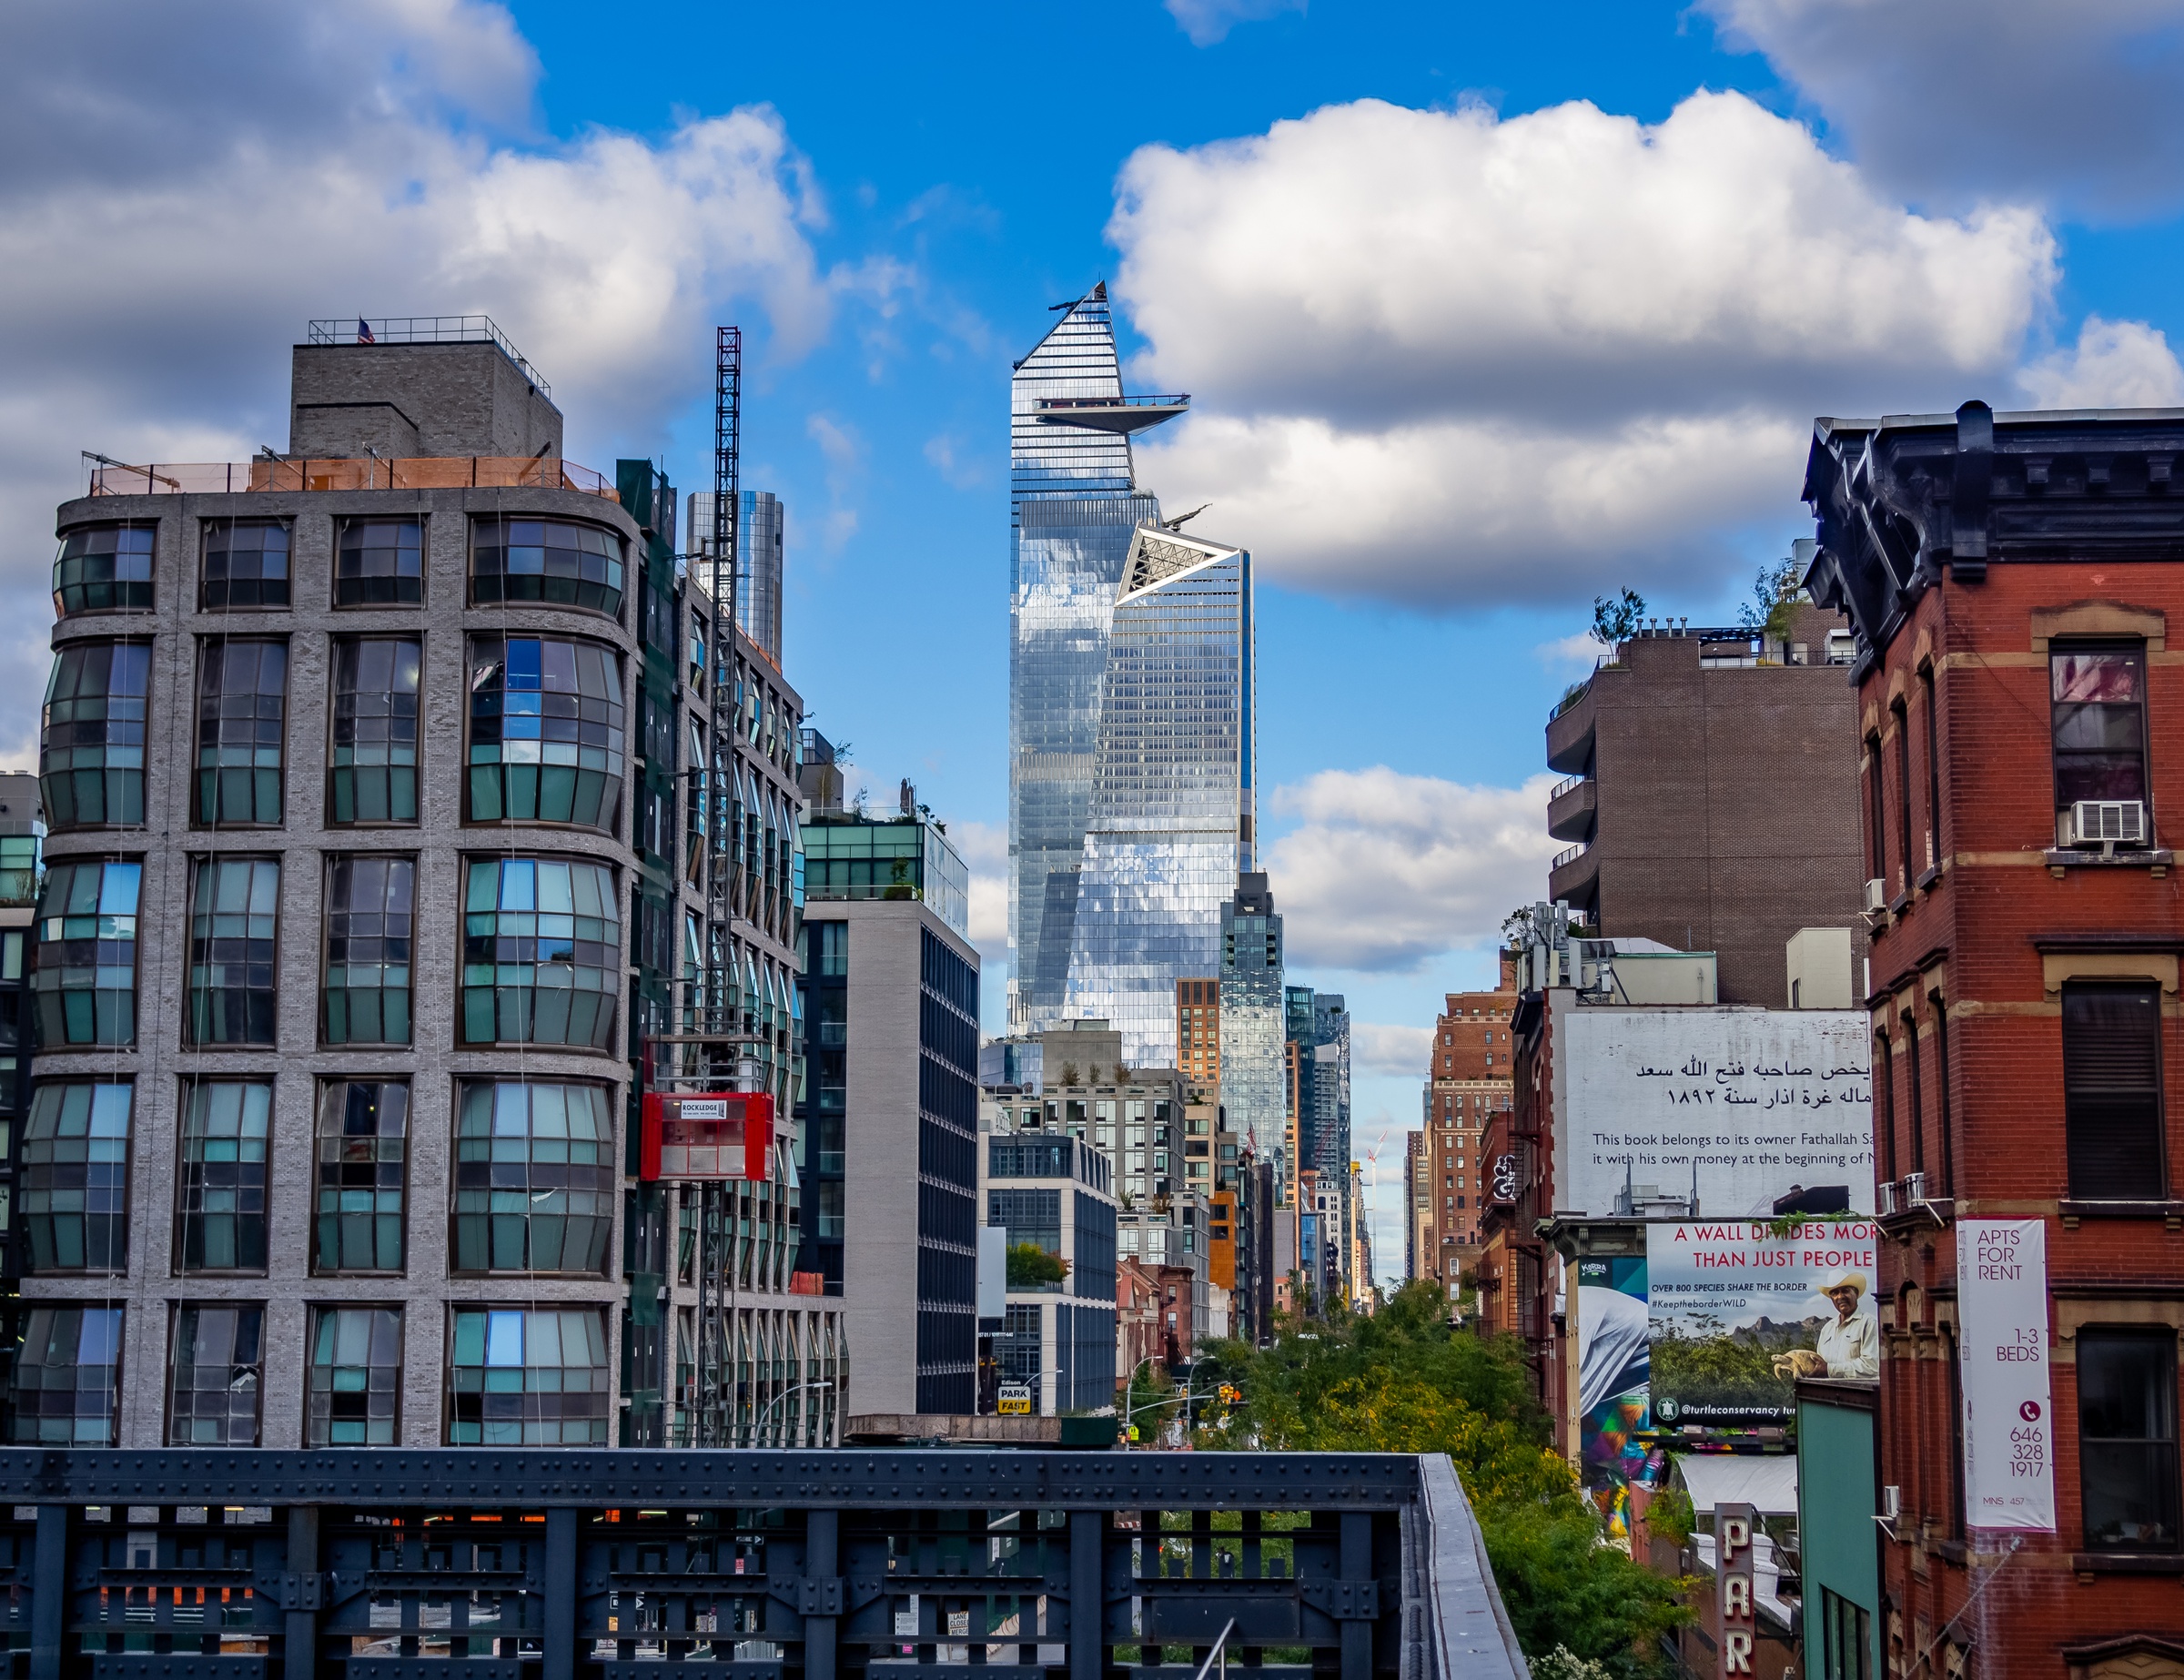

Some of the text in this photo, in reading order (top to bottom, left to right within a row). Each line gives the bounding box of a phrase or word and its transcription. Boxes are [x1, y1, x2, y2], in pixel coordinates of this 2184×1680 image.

[1636, 1066, 1673, 1077] سعد
[1681, 1054, 1706, 1076] الله
[1715, 1060, 1744, 1084] فتح
[1753, 1060, 1812, 1081] صاحبه
[1668, 1089, 1714, 1105] ١٨٩٢
[1724, 1088, 1757, 1104] سنة
[1802, 1088, 1832, 1108] غرة
[1592, 1133, 1620, 1145] This
[1624, 1133, 1657, 1145] book
[1663, 1133, 1711, 1149] belongs
[1716, 1135, 1730, 1145] to
[1734, 1134, 1749, 1145] its
[1754, 1136, 1796, 1145] owner
[1801, 1133, 1857, 1145] Fathallah
[1592, 1153, 1602, 1164] it
[1606, 1152, 1634, 1164] with
[1640, 1152, 1656, 1164] his
[1662, 1155, 1689, 1164] own
[1694, 1155, 1737, 1168] money
[1742, 1155, 1754, 1164] at
[1759, 1152, 1780, 1164] the
[1785, 1152, 1845, 1168] beginning
[1850, 1152, 1864, 1164] of
[1673, 1226, 1688, 1241] A
[1694, 1225, 1744, 1241] WALL
[1977, 1230, 2020, 1245] APTS
[1694, 1250, 1873, 1268] THAN JUST PEOPLE
[1978, 1247, 2015, 1262] FOR
[1978, 1265, 2022, 1280] RENT
[1652, 1282, 1807, 1292] OVER 800 SPECIES SHARE THE BORDER
[1652, 1299, 1746, 1311] #KeeptheborderWILD
[2014, 1328, 2038, 1343] 1-3
[1997, 1346, 2039, 1361] BEDS
[1001, 1390, 1026, 1398] PARK
[1682, 1404, 1779, 1416] @turtleconservancy
[2009, 1427, 2043, 1442] 646
[2013, 1444, 2043, 1460] 328
[2009, 1462, 2044, 1477] 1917
[1983, 1497, 2004, 1505] MNS
[2009, 1497, 2025, 1505] 457
[1723, 1515, 1752, 1674] PAR
